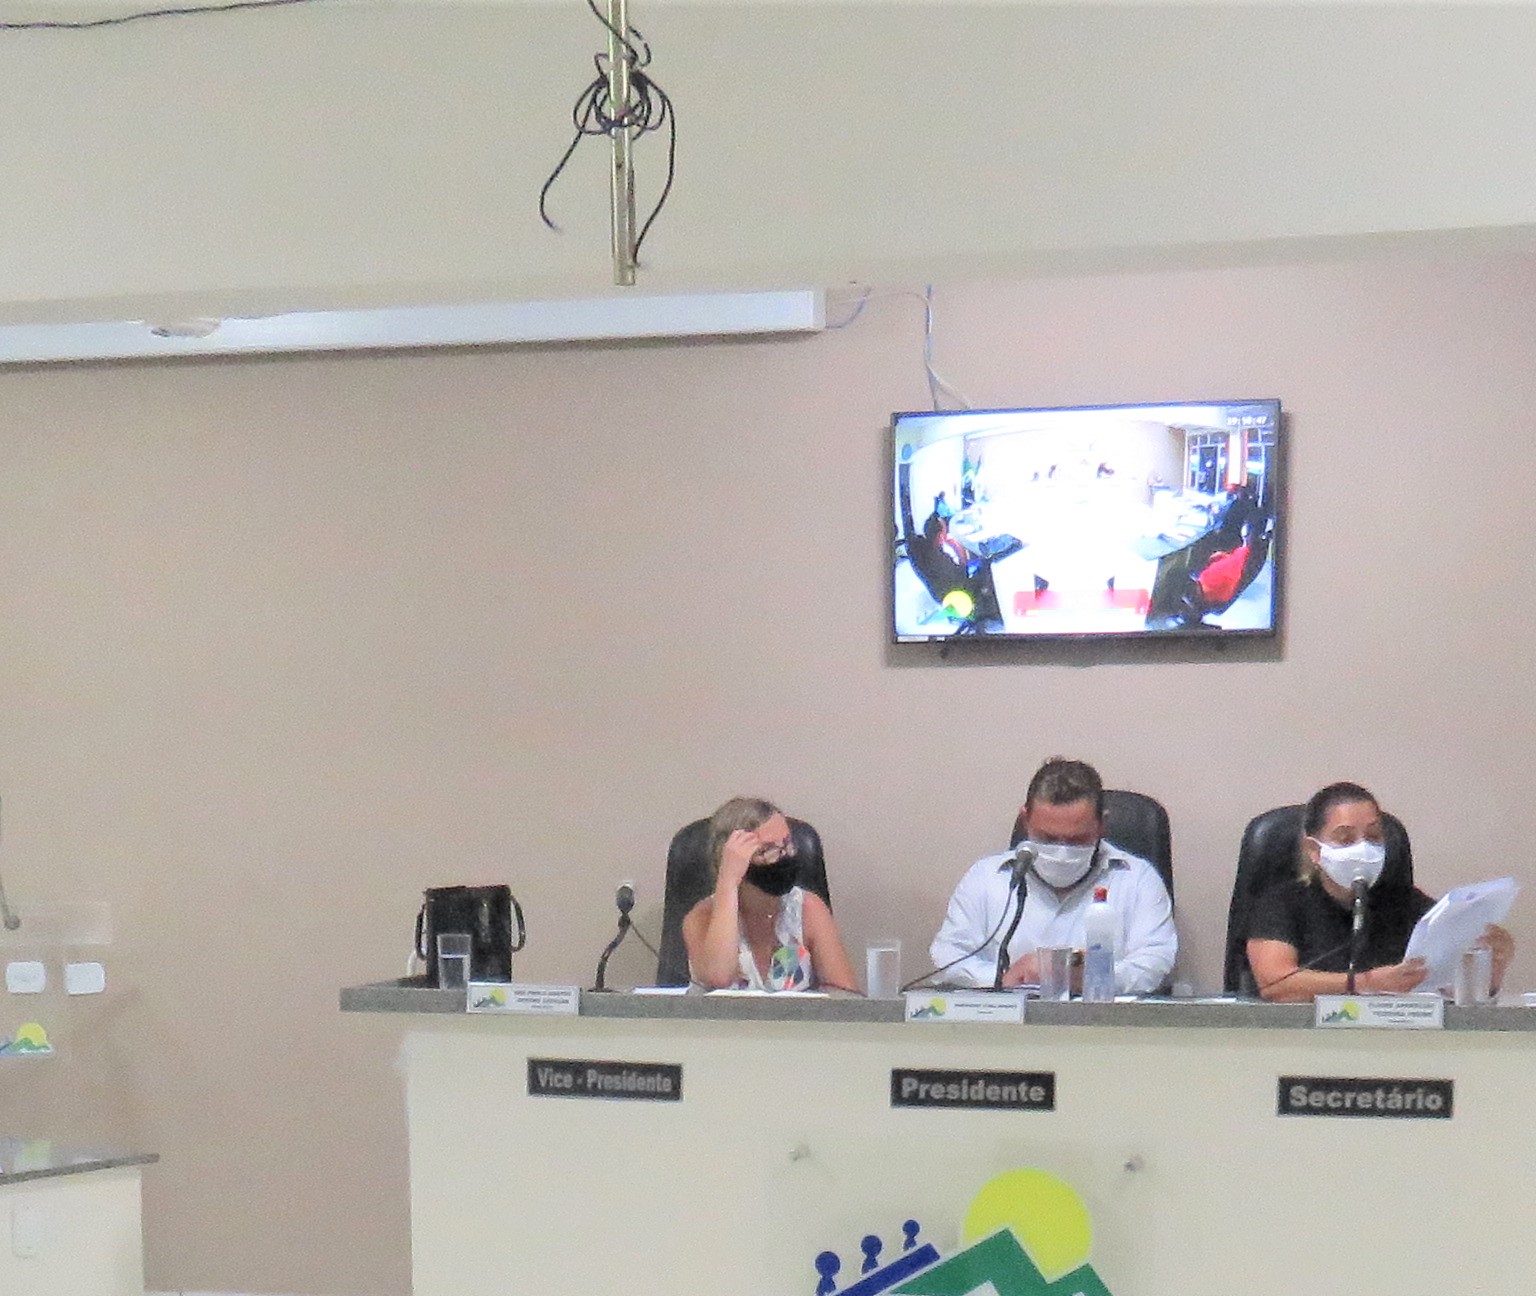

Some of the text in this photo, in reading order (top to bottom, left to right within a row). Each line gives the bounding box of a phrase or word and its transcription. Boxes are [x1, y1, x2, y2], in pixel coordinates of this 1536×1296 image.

[537, 1067, 574, 1089] Vice
[586, 1068, 673, 1093] Presidente
[901, 1077, 1046, 1102] Presidente
[1289, 1084, 1444, 1111] Secretário
